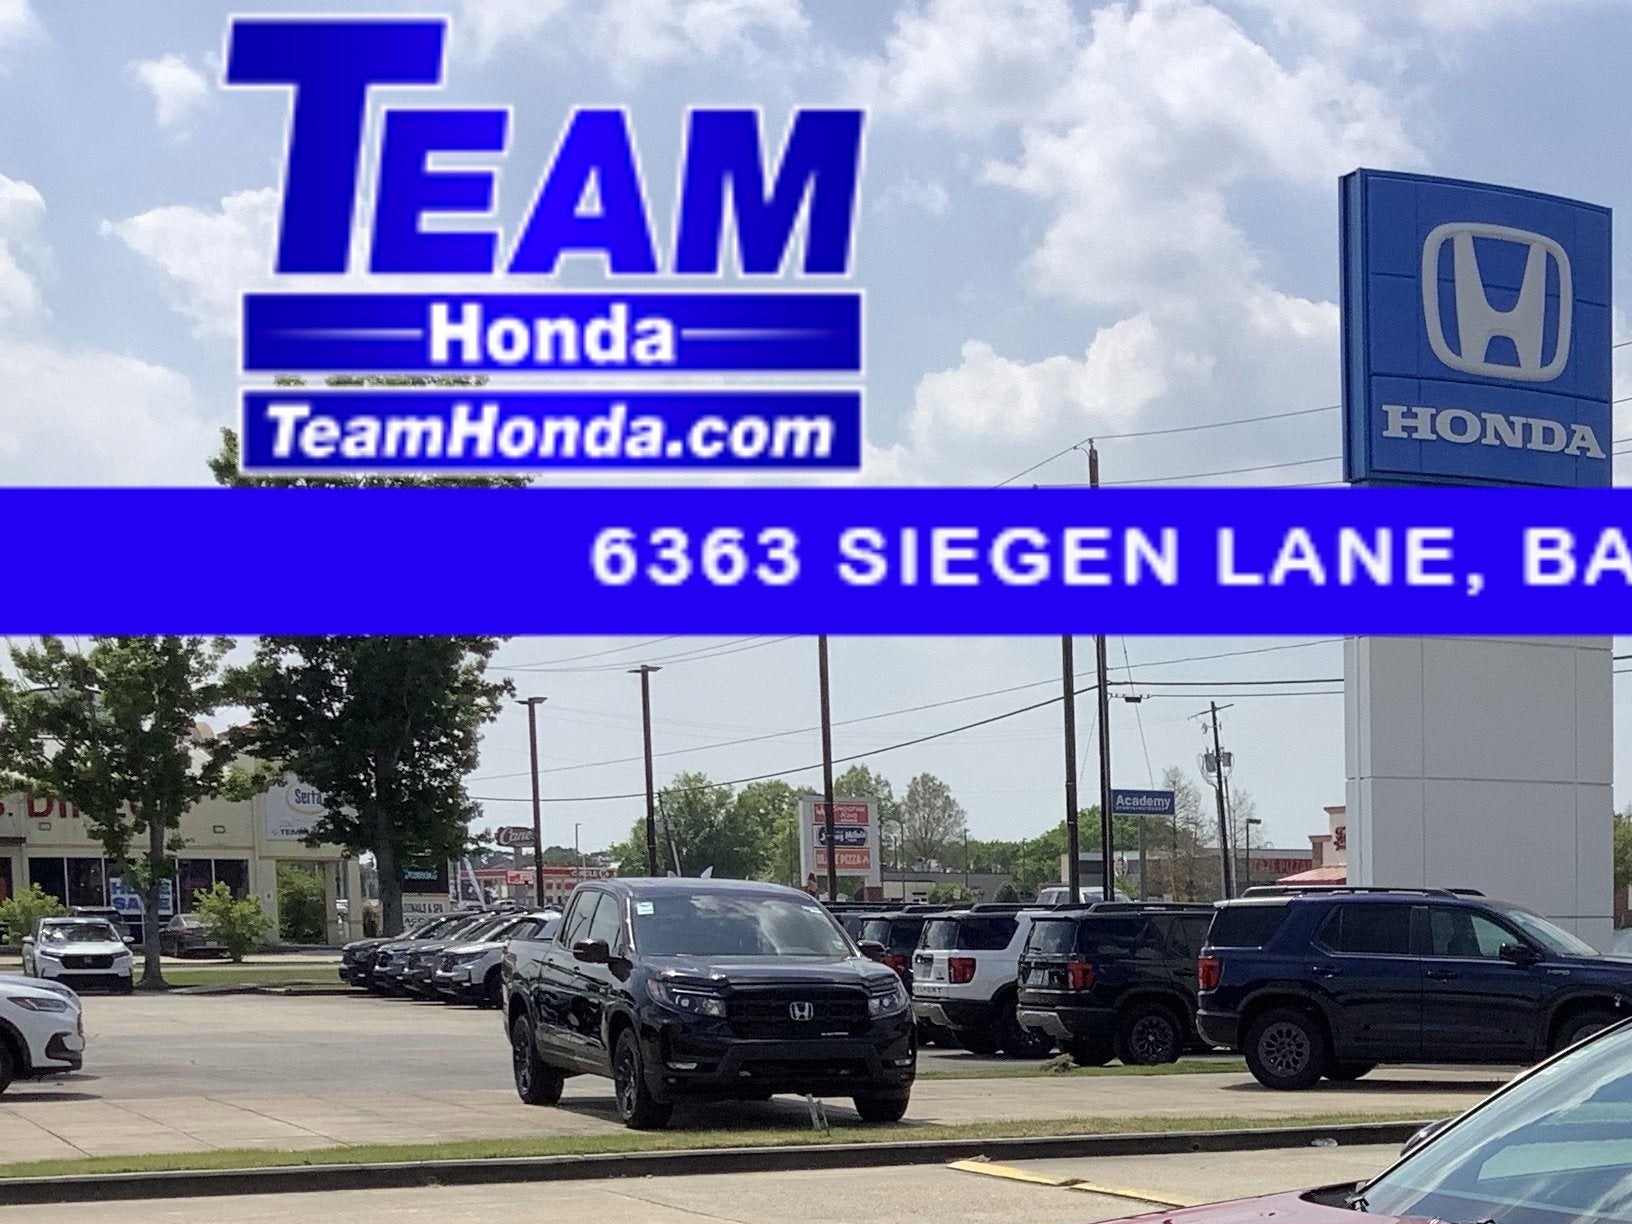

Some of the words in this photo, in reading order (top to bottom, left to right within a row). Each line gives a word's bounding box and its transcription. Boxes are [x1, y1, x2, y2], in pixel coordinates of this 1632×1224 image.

[1382, 405, 1606, 459] HONDA
[1116, 794, 1171, 810] Academy
[499, 827, 535, 845] Cane
[112, 897, 170, 910] SAE
